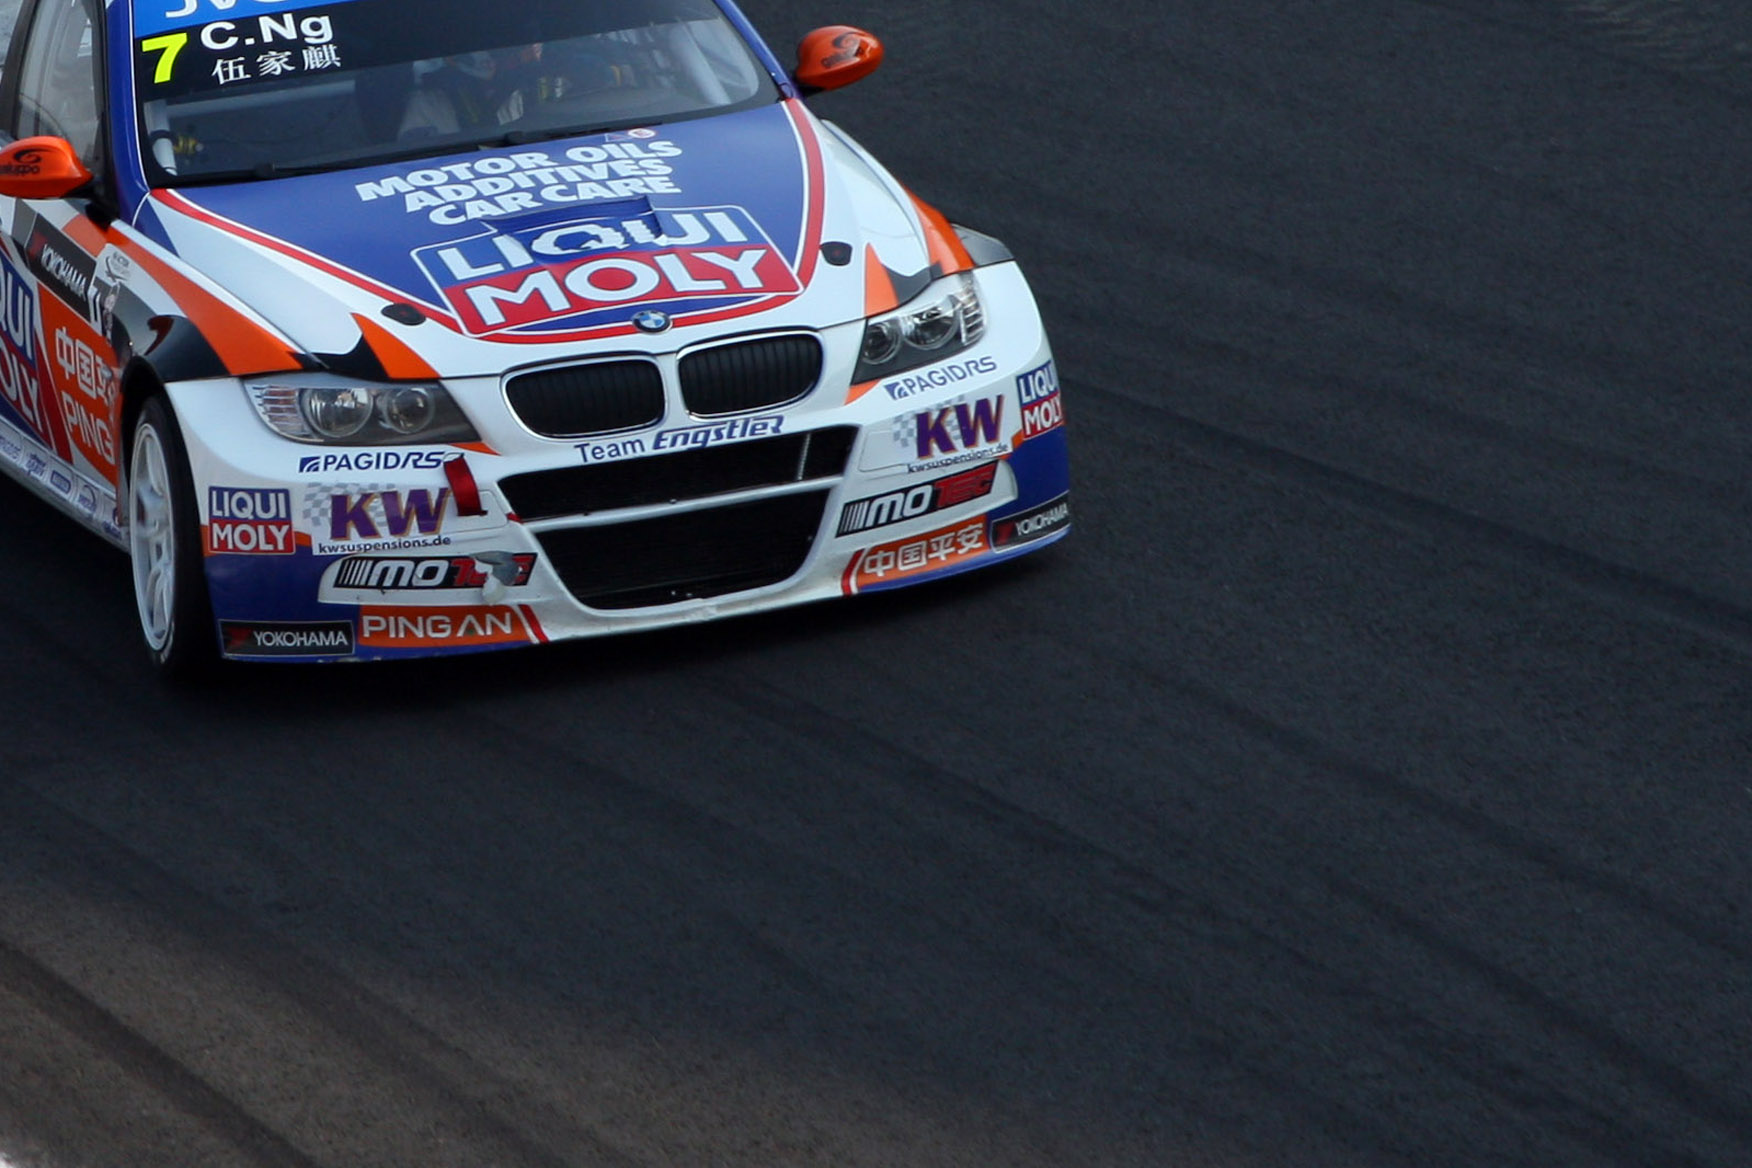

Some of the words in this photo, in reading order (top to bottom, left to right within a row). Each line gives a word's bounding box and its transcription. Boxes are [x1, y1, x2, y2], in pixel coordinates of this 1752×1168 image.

[141, 32, 189, 85] 7
[354, 151, 555, 201] MOTOR
[564, 141, 682, 165] OILS
[404, 158, 674, 213] ADDITIVES
[428, 188, 543, 226] CAR
[539, 174, 682, 204] CARE
[41, 243, 87, 302] YOKOHAMA
[437, 210, 749, 282] LIQUI
[464, 248, 770, 327] MOLY
[56, 326, 119, 424] 中国平
[1019, 364, 1057, 404] LIQU
[61, 390, 116, 465] PING
[574, 436, 647, 464] Team
[652, 414, 785, 450] Engstler
[915, 394, 1005, 460] KW
[211, 490, 287, 520] LIQUI
[330, 487, 451, 542] KW
[1016, 503, 1069, 536] YOKOHAMA
[211, 524, 291, 552] MOLY
[319, 536, 451, 554] kwsuspensions.de
[864, 522, 984, 577] 中国平安
[253, 630, 349, 647] YOKOHAMA
